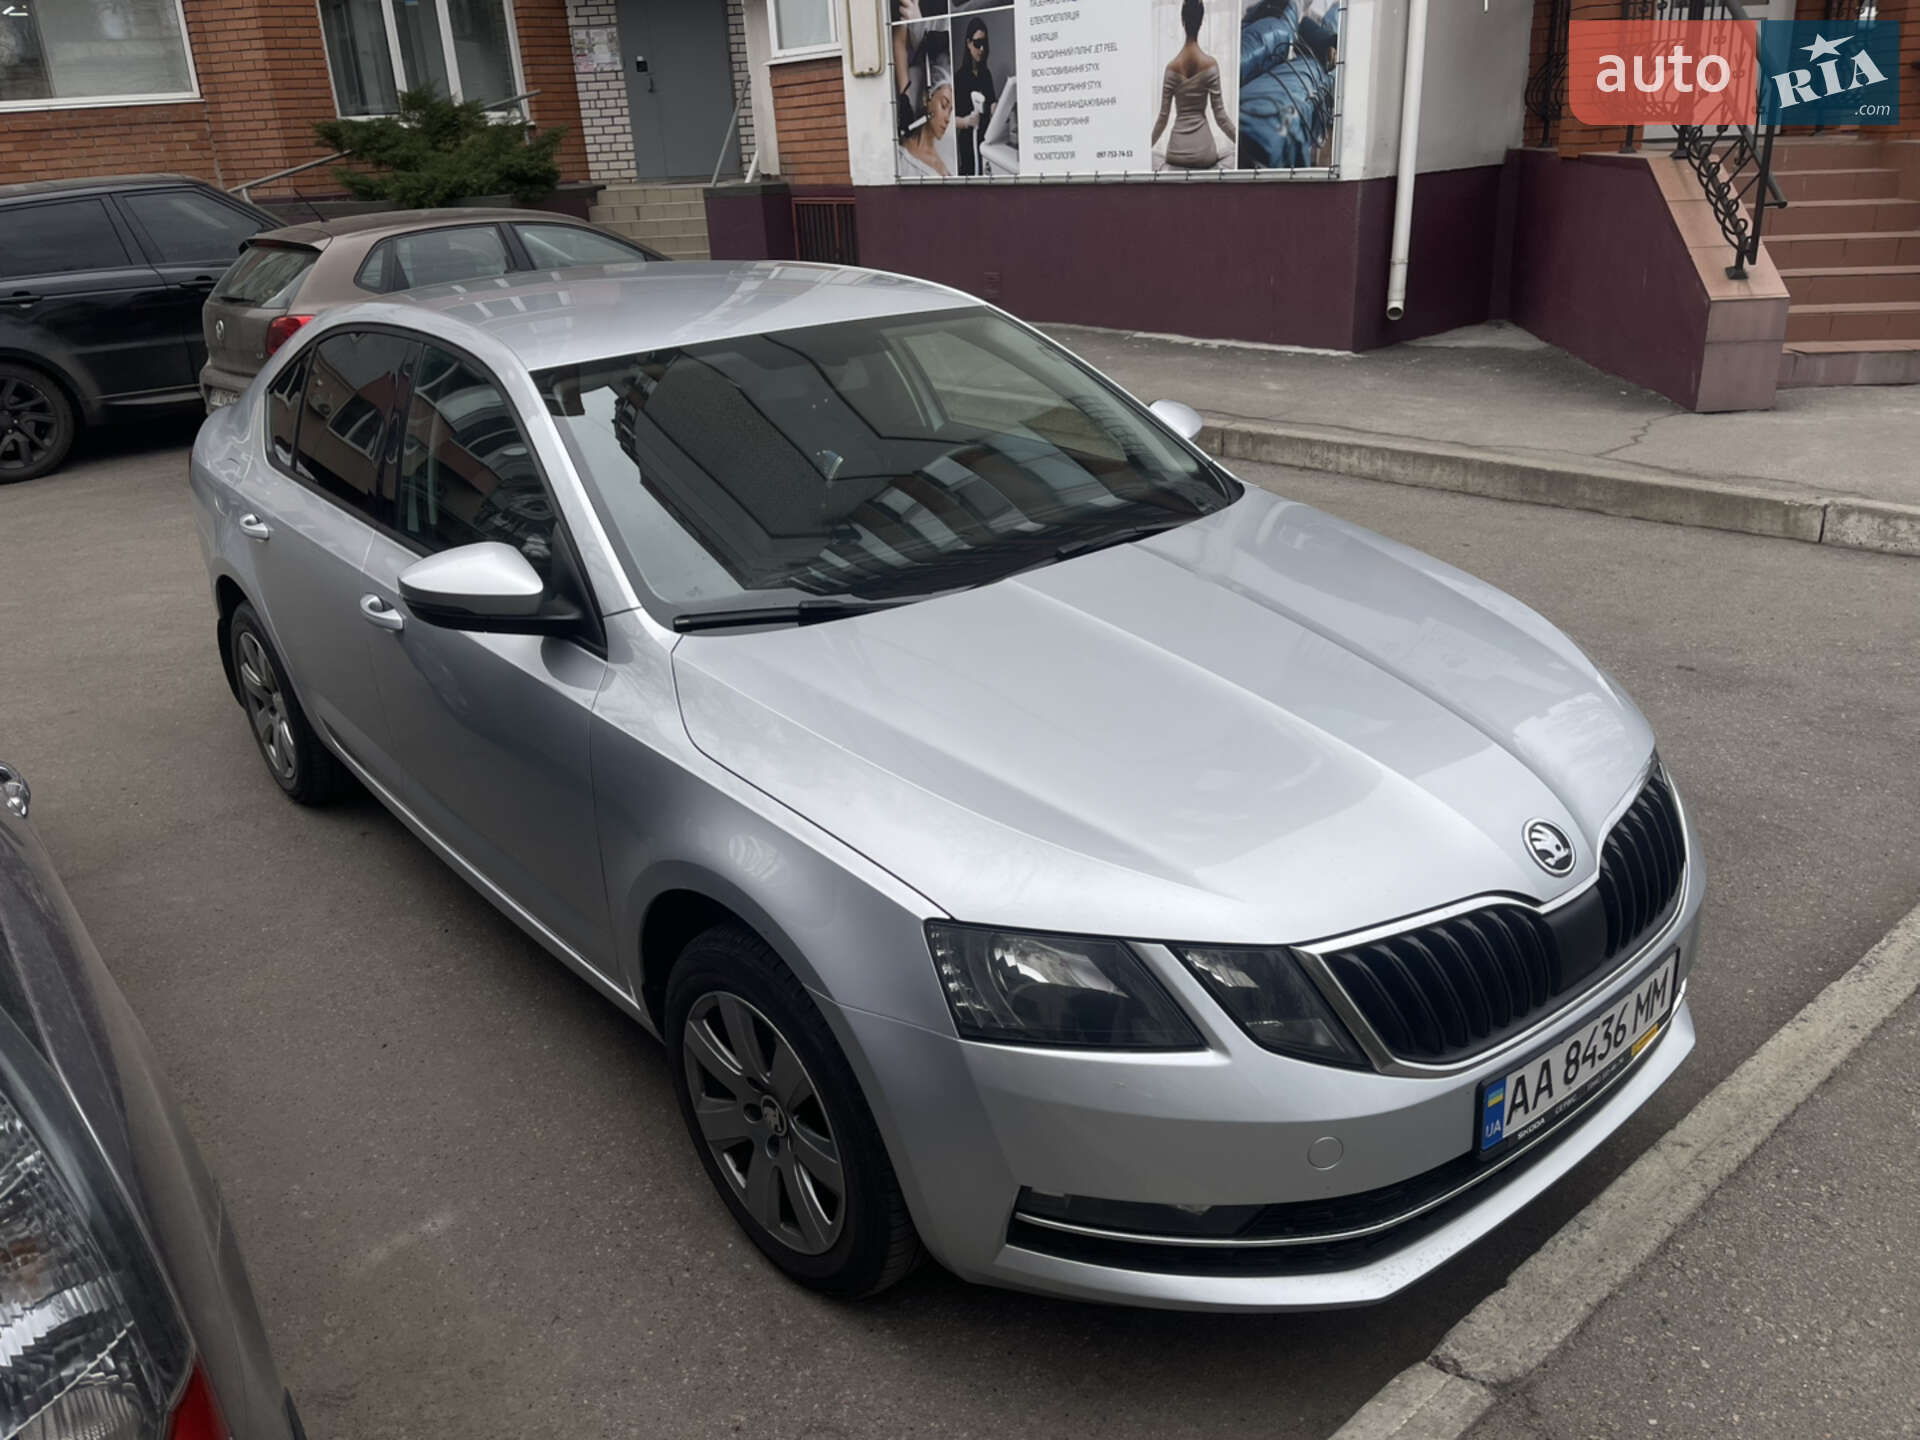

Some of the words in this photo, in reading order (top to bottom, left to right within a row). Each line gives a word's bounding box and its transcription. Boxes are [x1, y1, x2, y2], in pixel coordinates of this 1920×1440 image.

[1506, 1059, 1553, 1126] AA
[1563, 1002, 1629, 1086] 8436
[1632, 966, 1669, 1034] MM
[1485, 1119, 1502, 1138] UA
